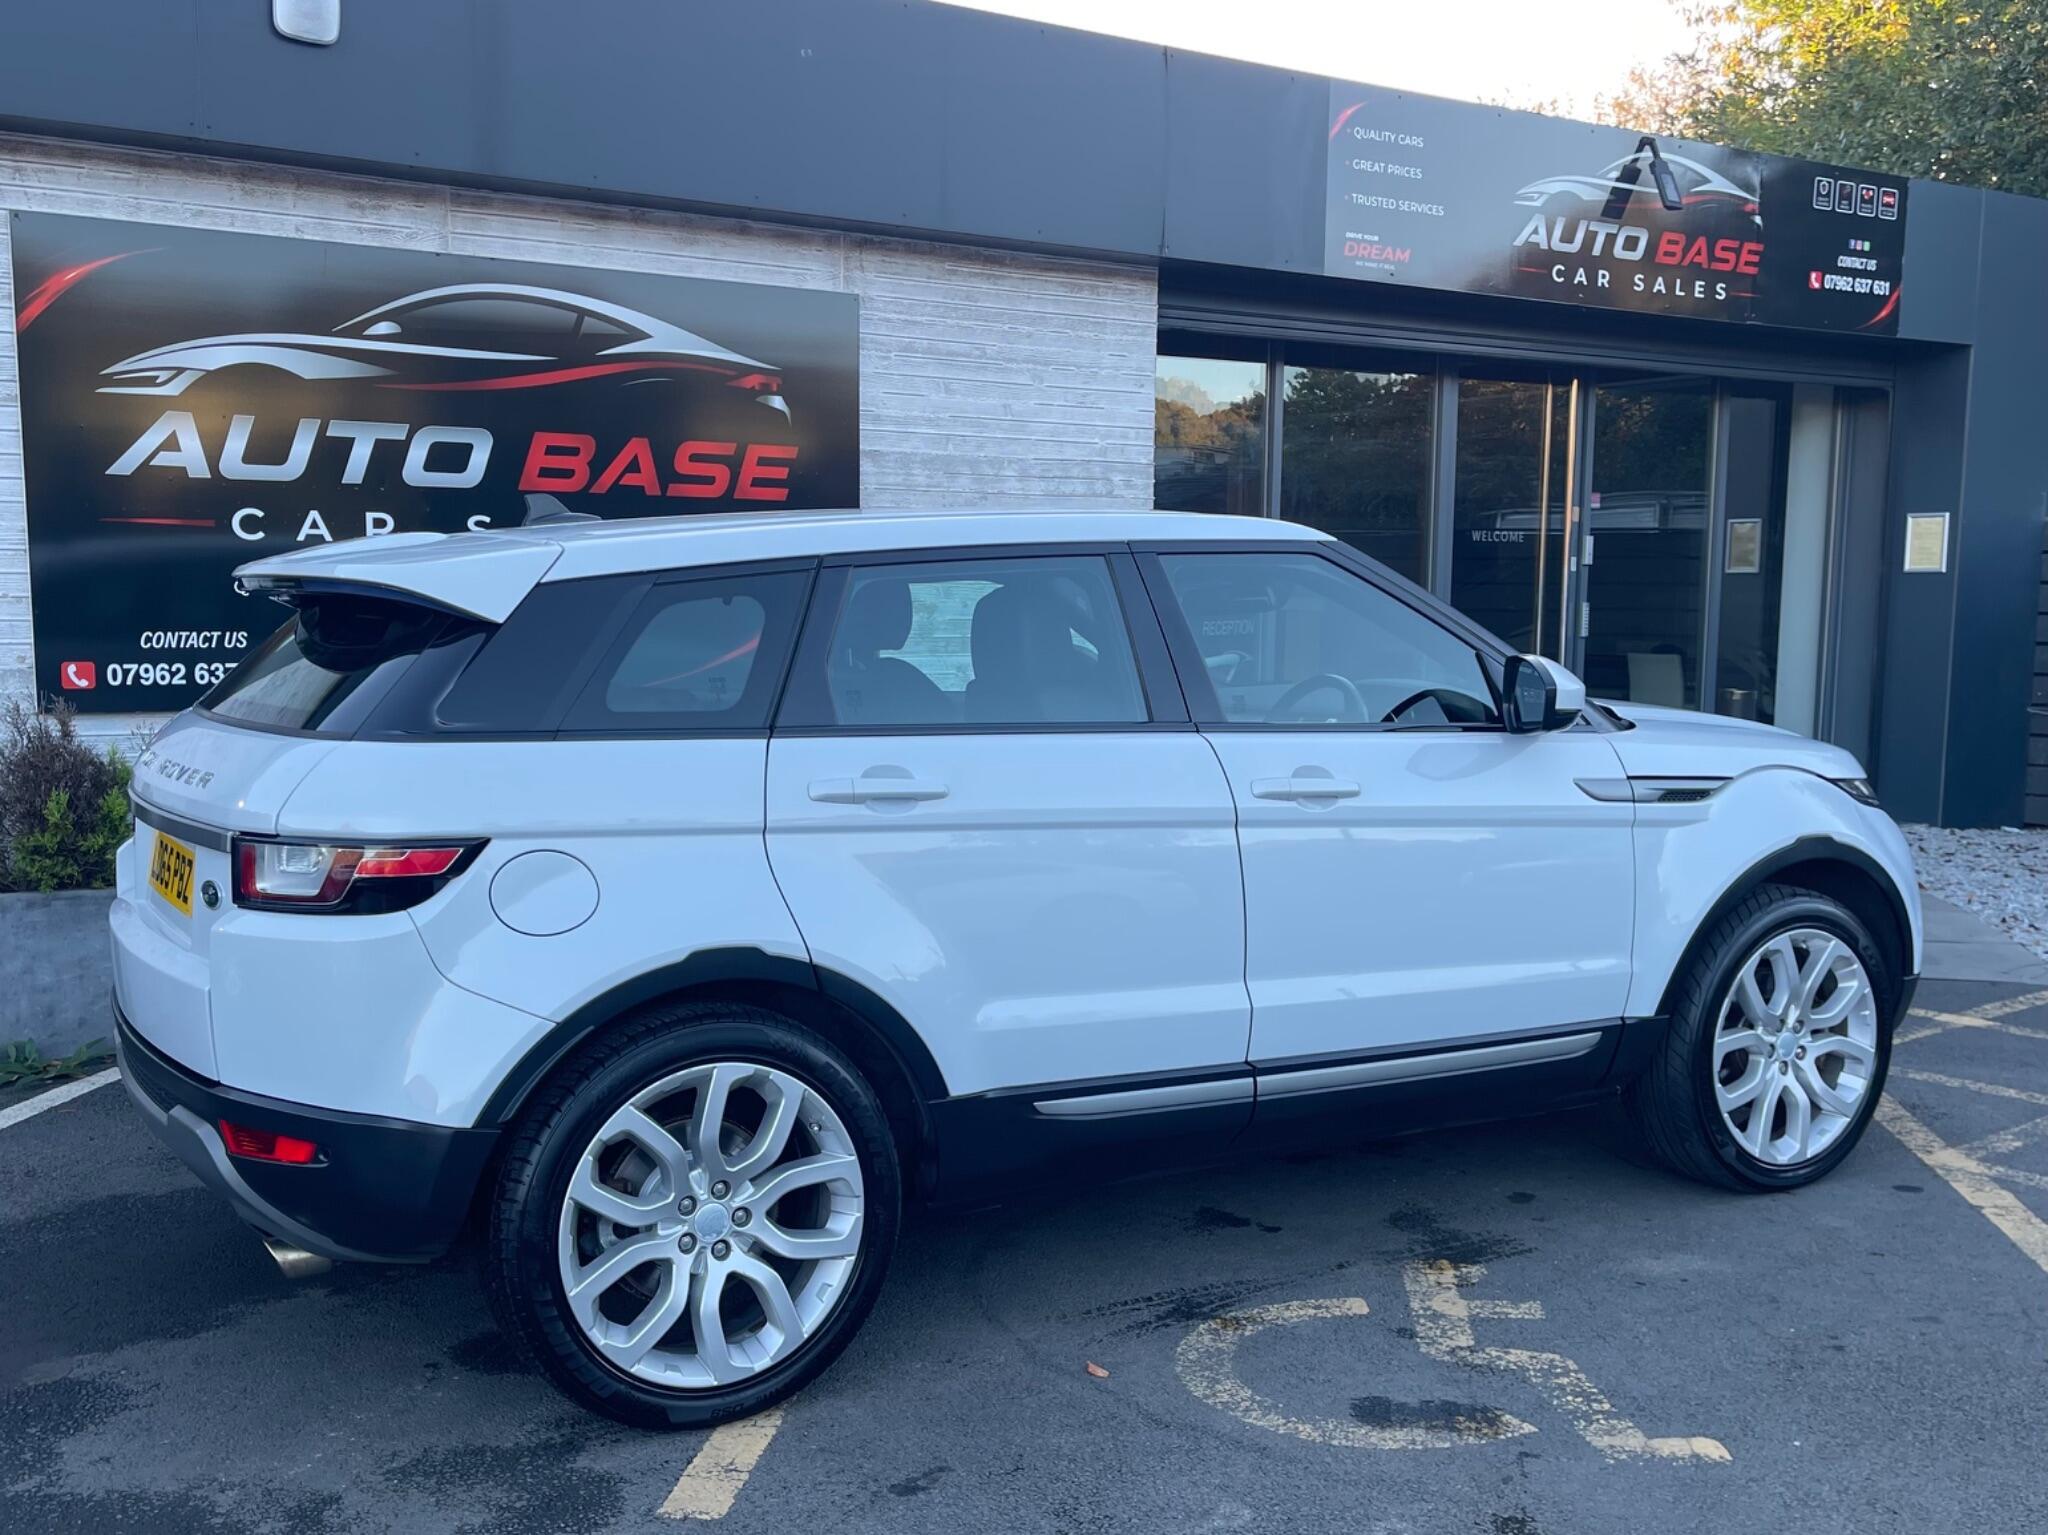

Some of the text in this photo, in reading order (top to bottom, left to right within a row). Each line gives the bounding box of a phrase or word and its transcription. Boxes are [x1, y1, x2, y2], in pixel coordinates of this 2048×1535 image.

[1353, 126, 1424, 148] QUALITY CARS
[1352, 159, 1422, 179] GREAT PRICES
[1352, 193, 1444, 216] TRUSTED SERVICES
[1344, 240, 1412, 263] DREAM
[1512, 213, 1765, 275] AUTO BASE
[1837, 255, 1866, 270] CONTACT
[1551, 264, 1727, 300] CAR SALES
[1823, 274, 1890, 296] 07962 637 631
[105, 410, 799, 502] AUTO BASE
[1471, 530, 1524, 543] WELCOME
[1202, 619, 1254, 637] RECEPTION
[140, 631, 248, 649] CONTACT US
[106, 663, 187, 686] 07962
